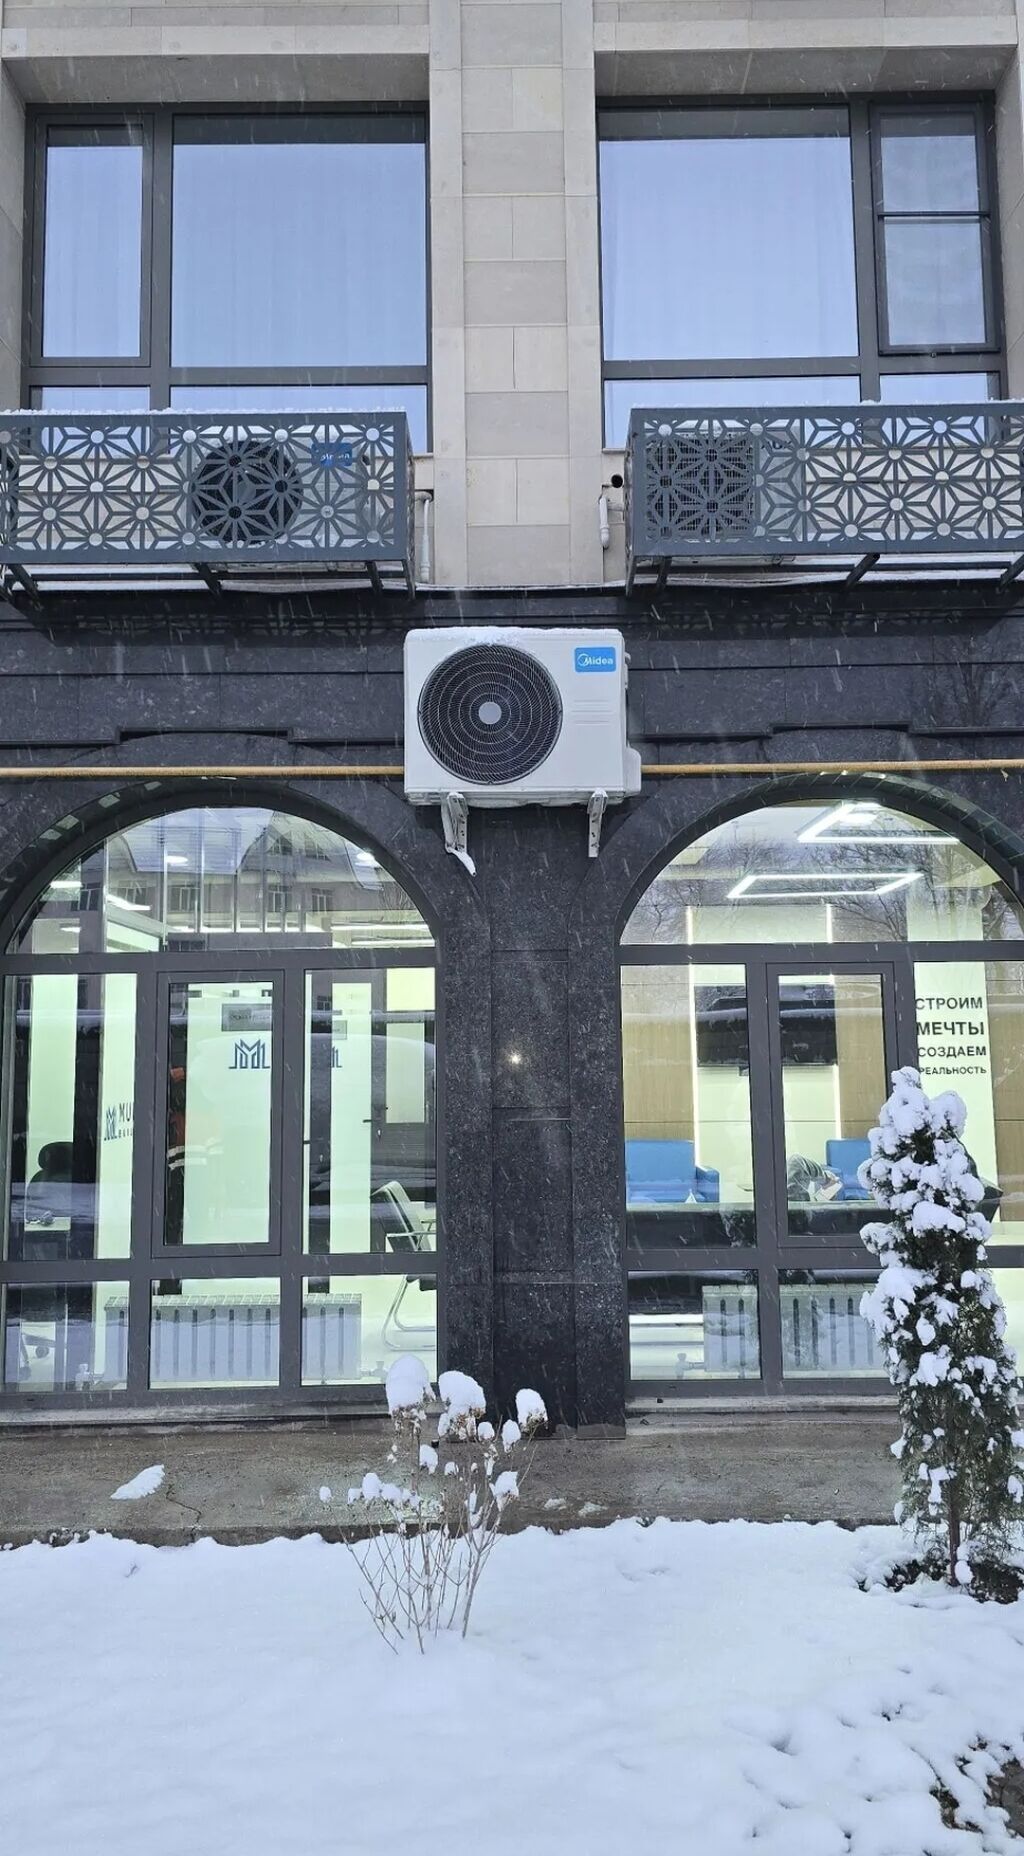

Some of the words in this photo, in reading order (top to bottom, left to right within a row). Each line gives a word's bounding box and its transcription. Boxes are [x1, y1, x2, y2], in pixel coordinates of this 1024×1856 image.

[578, 654, 614, 666] Midea
[915, 997, 983, 1010] СТРОИМ
[917, 1021, 985, 1036] МЕЧТЫ
[918, 1046, 987, 1059] СОЗДАЕМ
[919, 1066, 987, 1075] РЕАЛЬНОСТЬ
